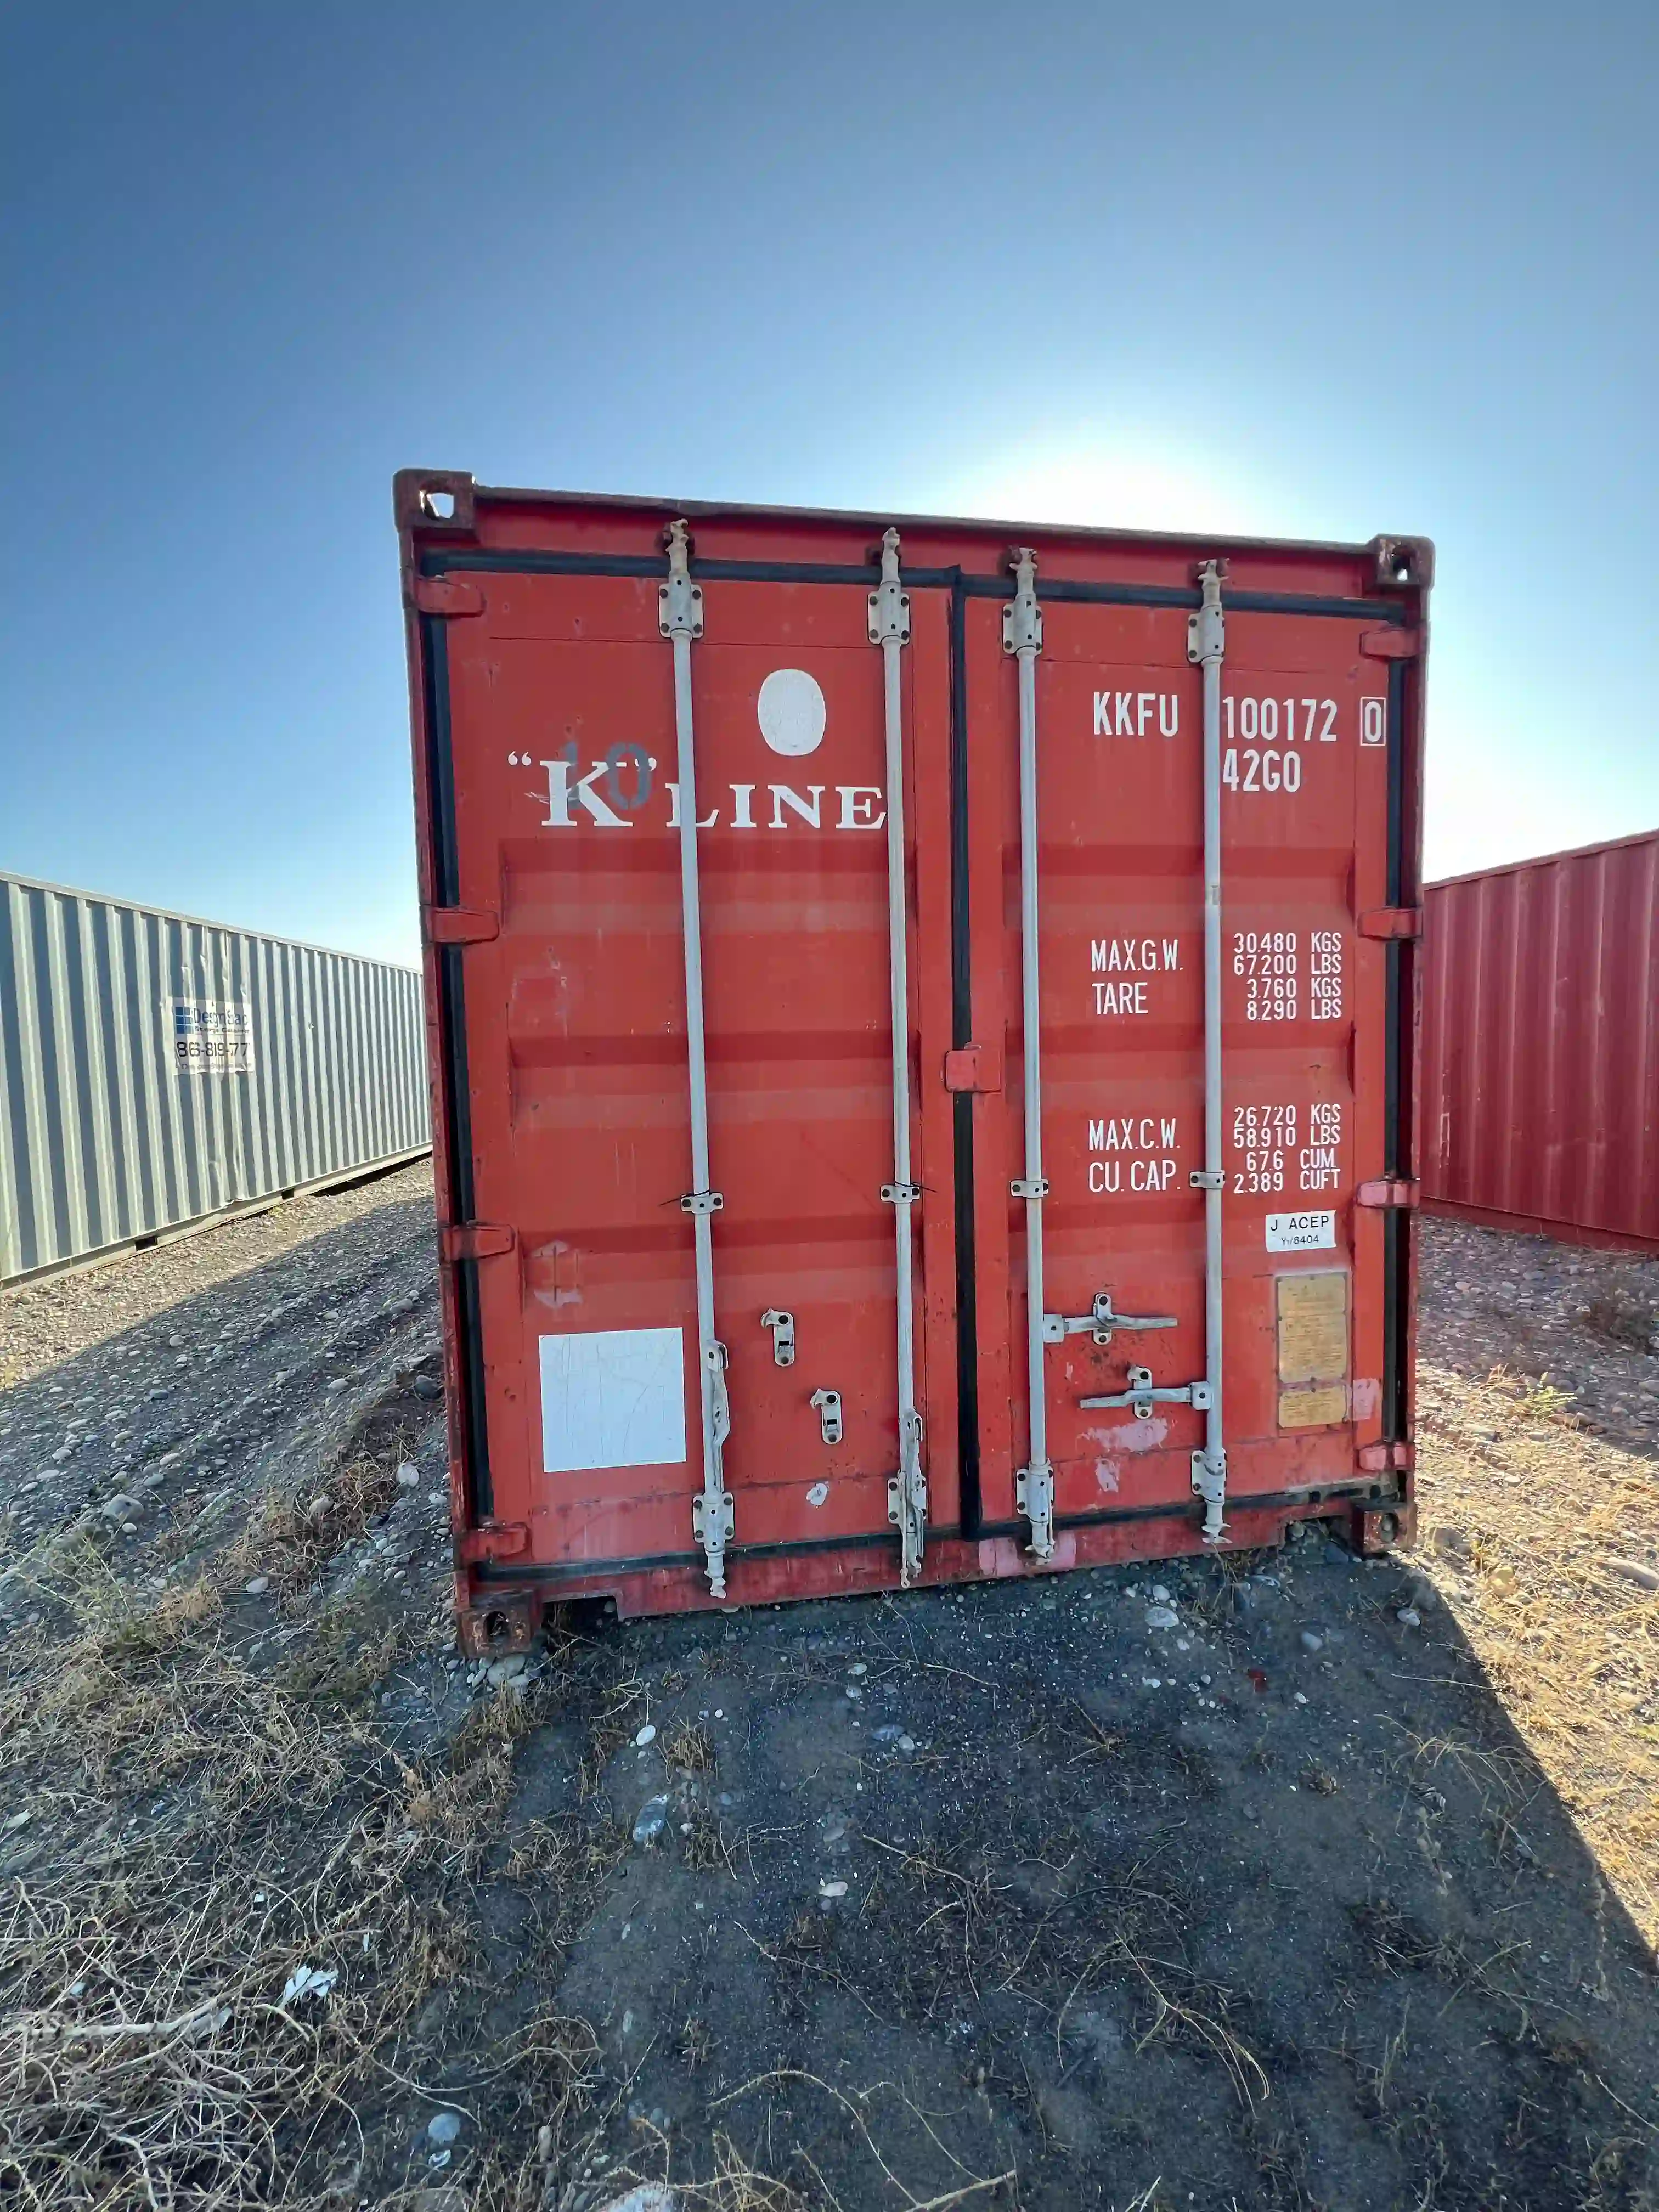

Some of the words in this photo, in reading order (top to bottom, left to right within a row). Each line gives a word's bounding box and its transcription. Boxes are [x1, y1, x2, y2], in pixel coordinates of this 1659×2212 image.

[1093, 691, 1178, 737] KKFU
[1222, 696, 1338, 742] 100172
[1222, 748, 1301, 793] 42G0
[665, 782, 887, 830] LINE
[1234, 932, 1296, 953] 30.480
[1311, 932, 1342, 952] KGS
[1091, 939, 1183, 972] MAX.G.W.
[1234, 954, 1296, 975] 67.200
[1311, 953, 1342, 974] LBS
[1092, 981, 1148, 1014] TARE
[1246, 978, 1297, 998] 3.760
[1311, 977, 1342, 998] KGS
[1246, 1000, 1297, 1020] 8.290
[1311, 998, 1342, 1019] LBS
[1234, 1105, 1296, 1127] 26.720
[1311, 1103, 1341, 1124] KGS
[1088, 1118, 1181, 1151] MAX.C.W.
[1234, 1126, 1296, 1148] 58.910
[1310, 1125, 1341, 1146] LBS
[1246, 1150, 1284, 1171] 67.6
[1088, 1161, 1124, 1193] CU.
[1130, 1160, 1181, 1192] CAP.
[1233, 1171, 1284, 1194] 2.389
[1270, 1218, 1278, 1231] J
[1289, 1216, 1329, 1229] ACEP
